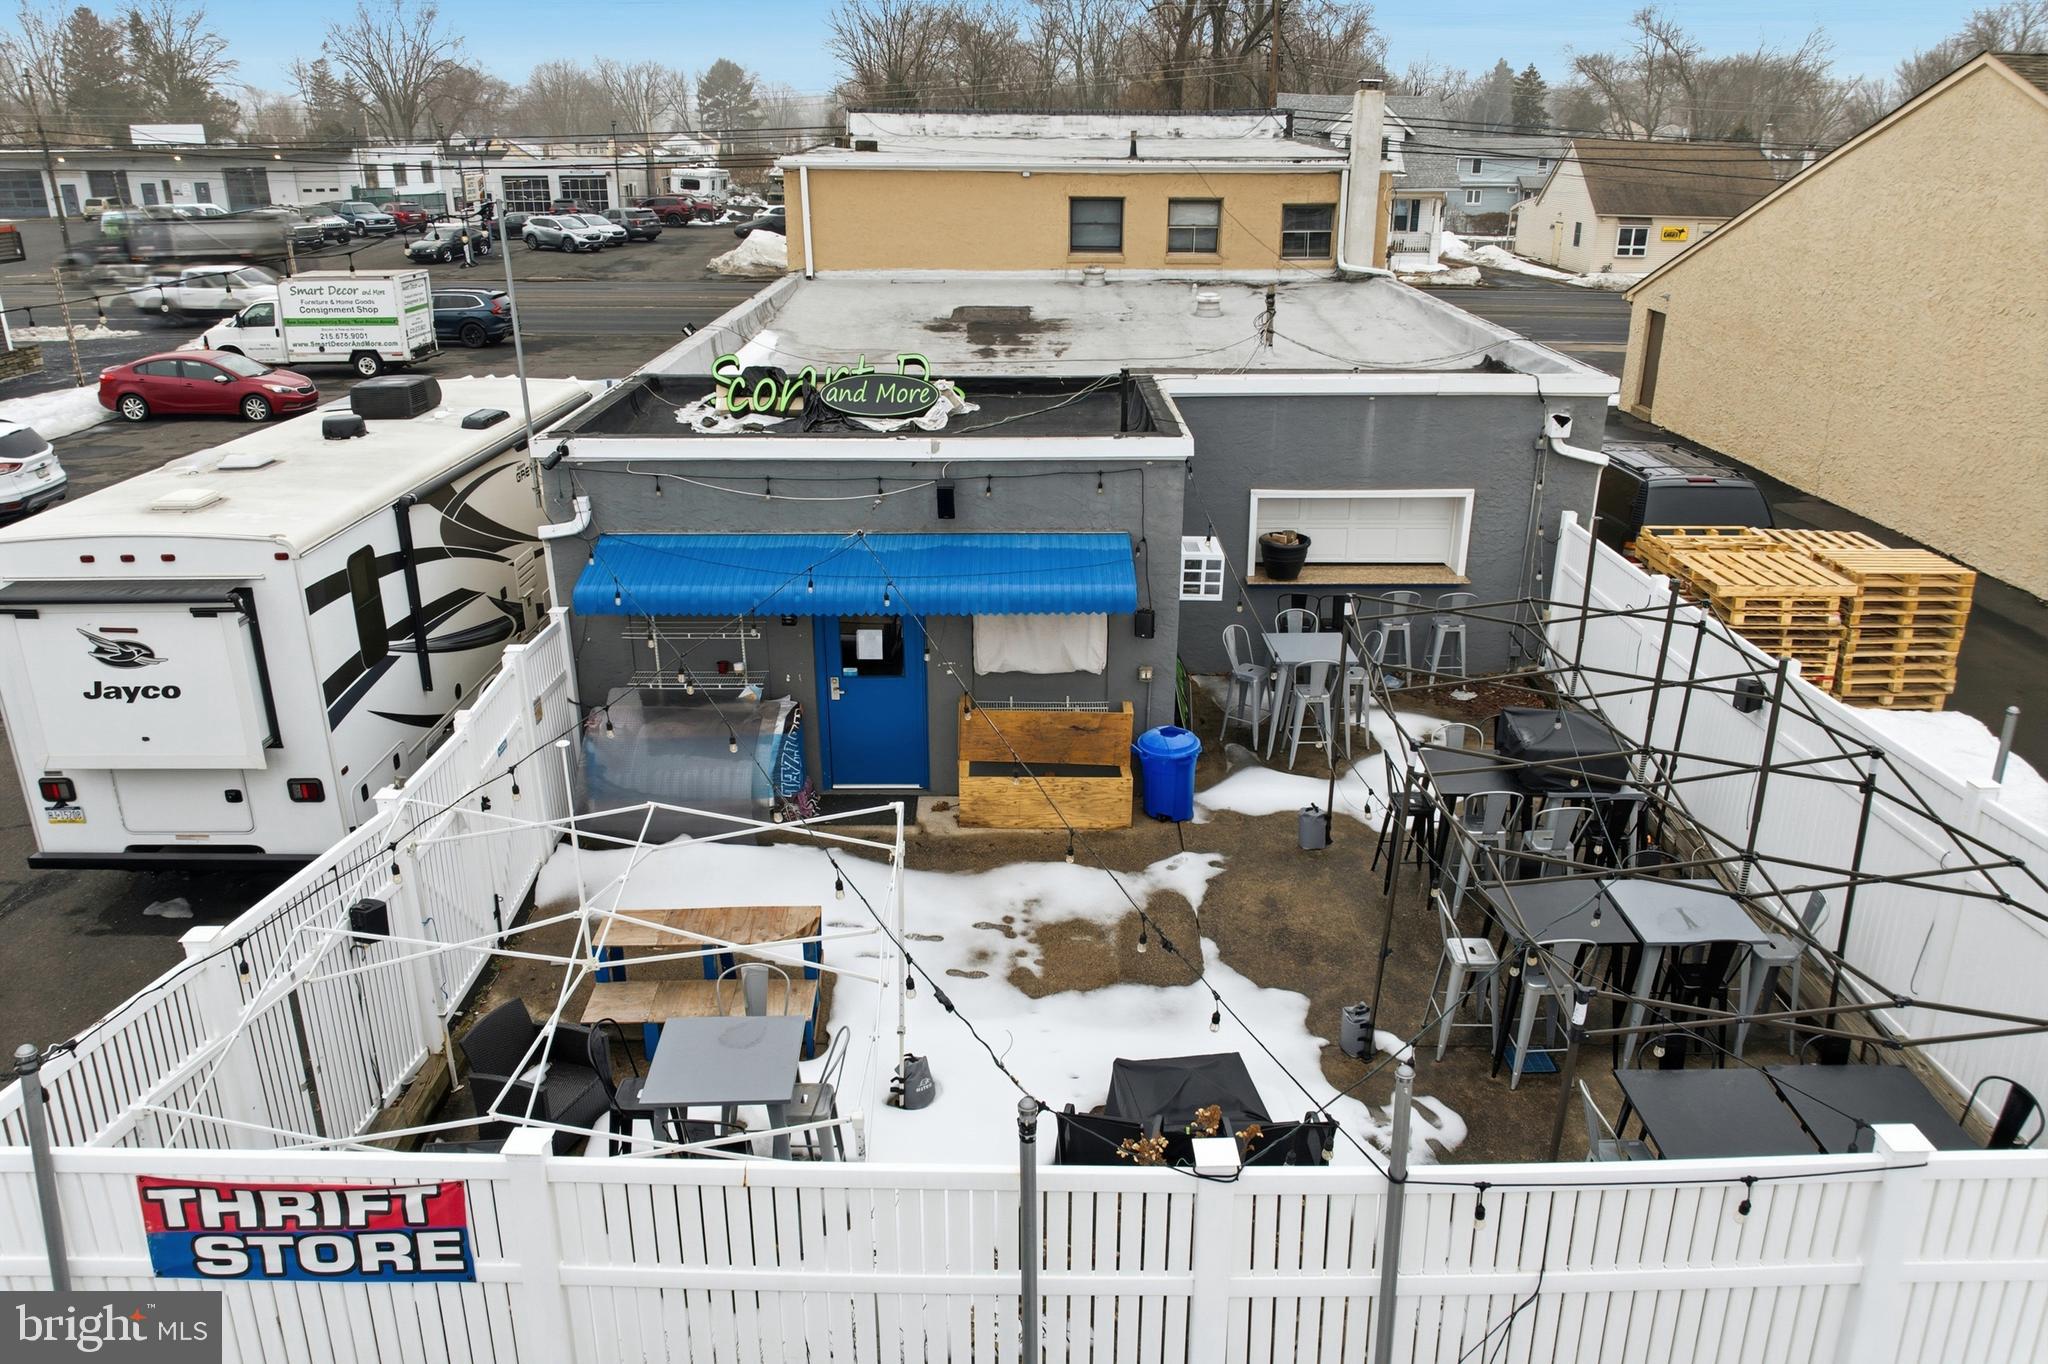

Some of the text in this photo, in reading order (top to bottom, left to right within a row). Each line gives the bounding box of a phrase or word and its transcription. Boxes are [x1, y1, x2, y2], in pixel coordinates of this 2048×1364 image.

[290, 286, 324, 296] Smart
[328, 286, 359, 296] Decor
[299, 306, 379, 315] Consignment Shop
[825, 379, 931, 404] and More
[83, 680, 182, 704] Jayco
[144, 1184, 441, 1230] THRIFT
[192, 1230, 467, 1277] STORE
